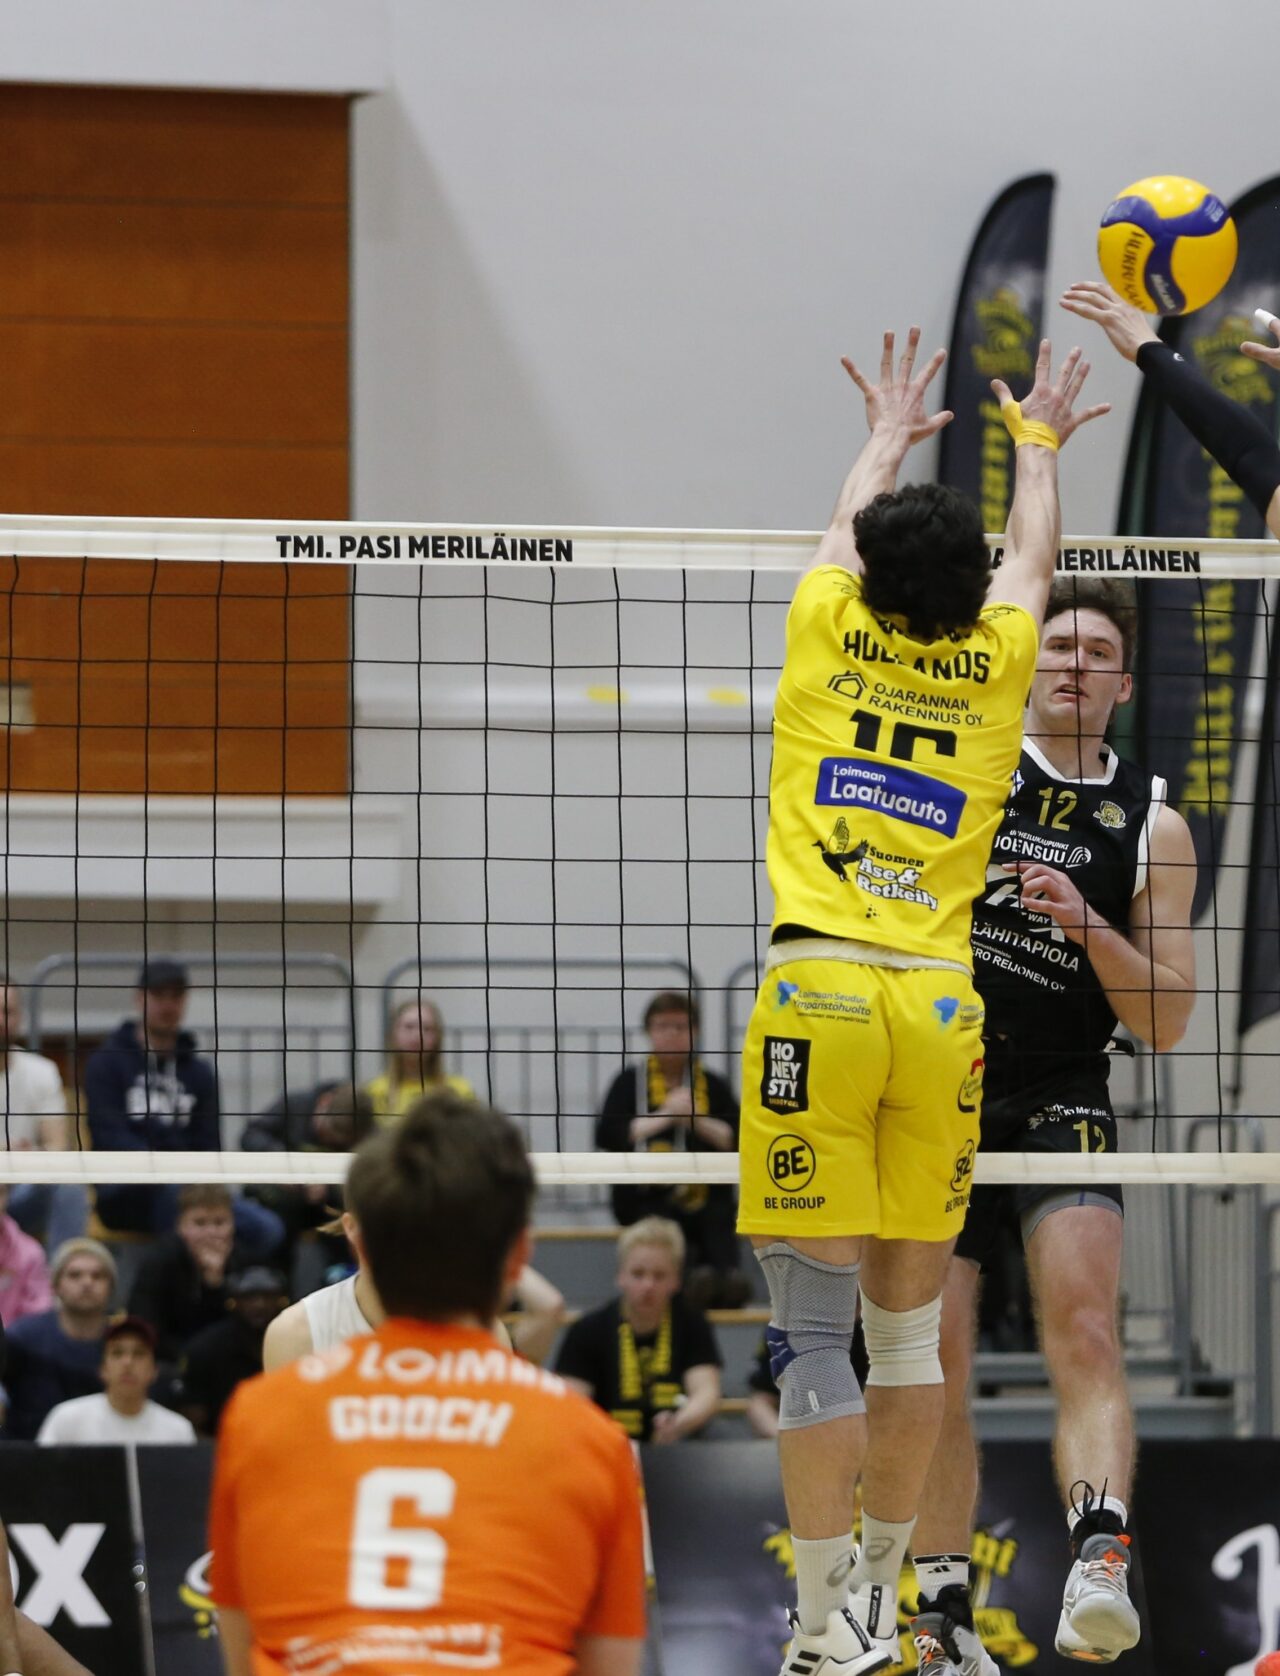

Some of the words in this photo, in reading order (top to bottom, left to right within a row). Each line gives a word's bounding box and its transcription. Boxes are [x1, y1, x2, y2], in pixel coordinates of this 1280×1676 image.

[277, 535, 332, 559] TMI.
[339, 535, 401, 560] PASI
[408, 532, 573, 563] MERILÄINEN
[844, 629, 991, 684] HOLANDS
[869, 696, 961, 725] RAKENNUS
[965, 714, 983, 726] OY
[874, 682, 970, 711] OJARANNAN
[833, 764, 887, 783] Loimaan
[830, 777, 947, 825] Laatuauto
[1038, 787, 1077, 831] 12
[869, 847, 925, 867] Suomen
[994, 836, 1066, 863] JOENSUU
[858, 857, 897, 881] Ase
[897, 866, 921, 887] &
[856, 873, 938, 911] Retkeily
[1027, 914, 1051, 924] WAY
[972, 921, 1080, 972] LÄHITAPIOLA
[973, 946, 991, 961] RO
[992, 954, 1048, 987] REIJONEN
[770, 1042, 795, 1061] HO
[771, 1060, 802, 1080] NEY
[768, 1078, 798, 1098] STY
[774, 1145, 809, 1180] BE
[765, 1196, 778, 1209] BE
[781, 1196, 826, 1210] GROUP
[330, 1394, 514, 1447] GOOCH
[348, 1467, 456, 1610] 6
